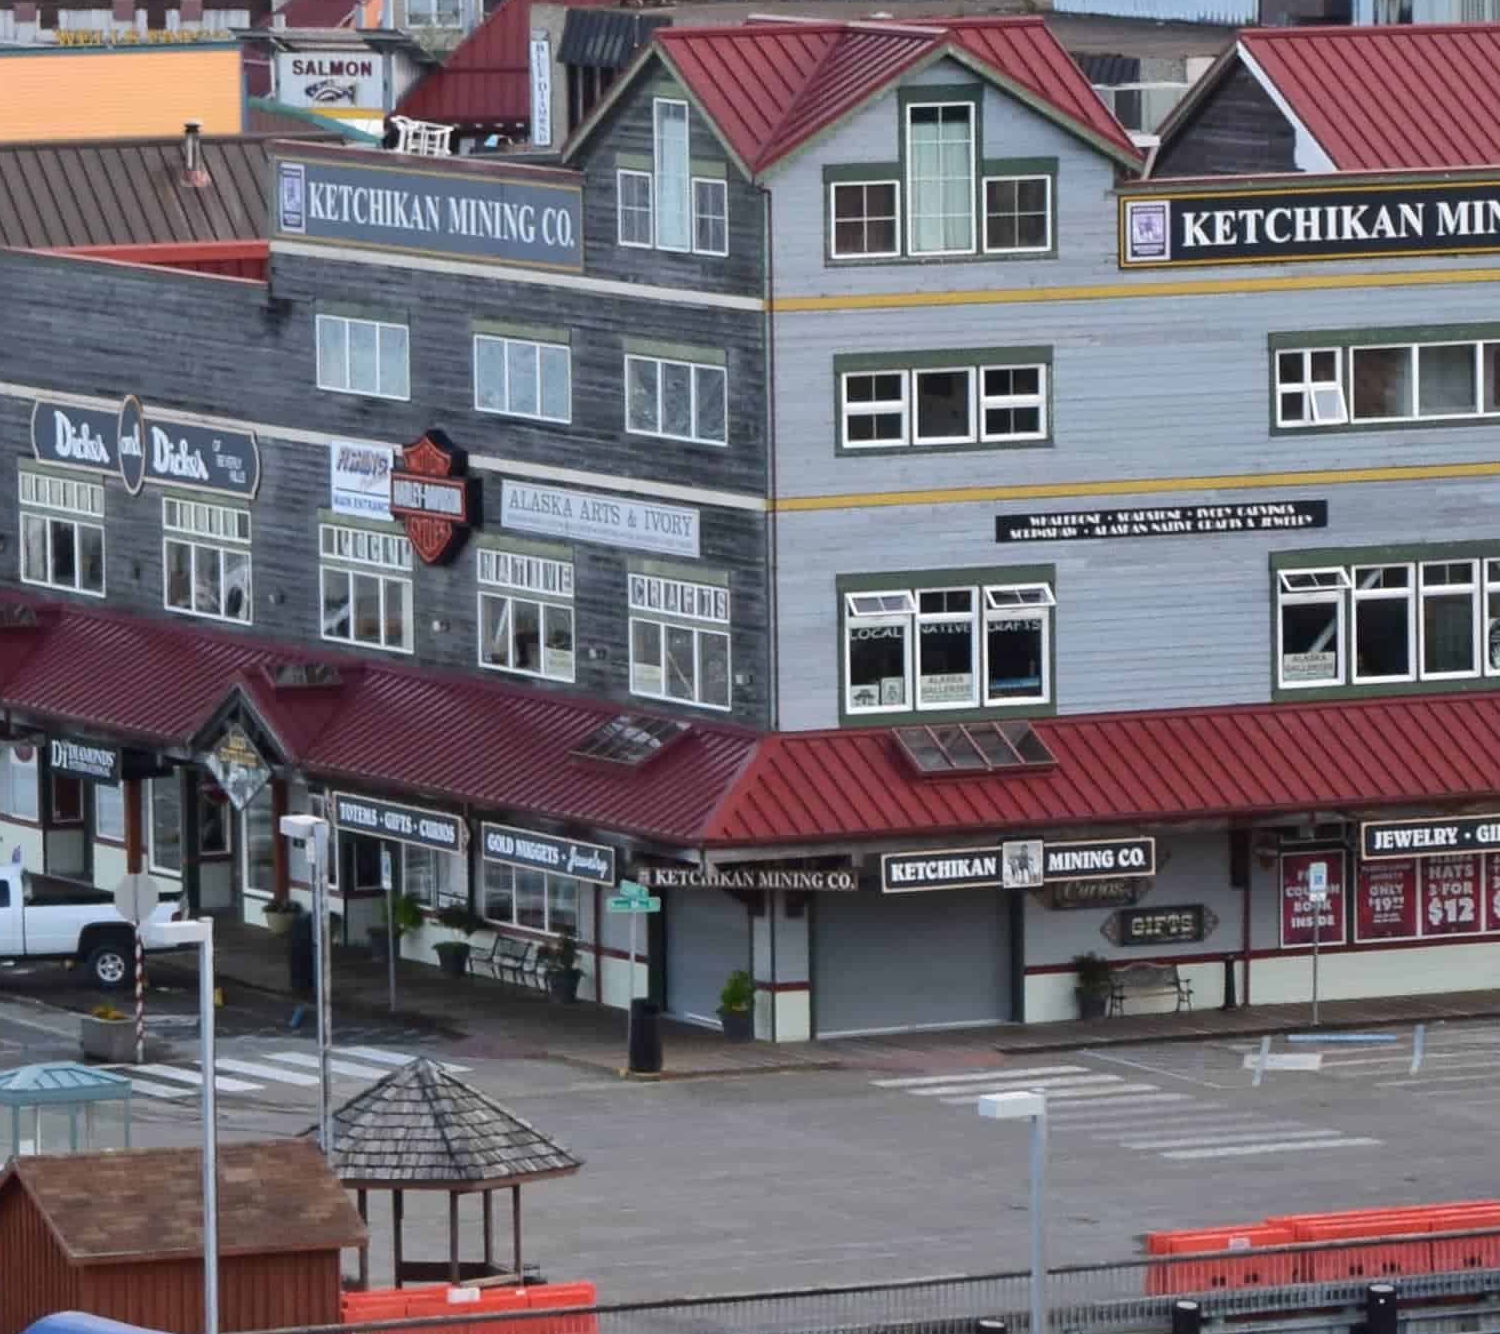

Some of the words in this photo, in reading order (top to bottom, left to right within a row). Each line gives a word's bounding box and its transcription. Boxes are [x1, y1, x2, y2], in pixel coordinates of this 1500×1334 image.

[292, 59, 373, 76] SALMON
[308, 181, 440, 233] KETCHIKAN
[448, 196, 535, 244] MINING
[542, 206, 576, 248] CO.
[1182, 202, 1425, 247] KETCHIKAN
[120, 423, 143, 458] and
[509, 490, 573, 517] ALASKA
[579, 499, 621, 525] ARTS
[627, 510, 637, 528] &
[644, 509, 693, 538] IVORY
[1009, 527, 1077, 540] SCRIMSHAW
[1094, 523, 1148, 537] ALASKAN
[1152, 520, 1192, 534] NATIVE
[1198, 517, 1242, 531] CRAFTS
[1246, 516, 1255, 528] &
[1261, 514, 1313, 527] JEWELRY
[1029, 513, 1100, 527] WHALEBONE
[1117, 509, 1182, 523] SOAPSTONE
[1196, 506, 1231, 519] IVORY
[1237, 503, 1294, 517] CARVINGS
[481, 551, 572, 595] NATIVE
[631, 577, 728, 618] CRAFTS
[850, 627, 904, 641] LOCAL
[987, 618, 1042, 633] CRAFTS
[339, 801, 377, 824] TOTEMS
[384, 810, 412, 833] GIFTS
[419, 818, 455, 844] CURIOS
[1374, 826, 1458, 850] JEWELRY
[487, 832, 514, 855] GOLD
[515, 836, 559, 865] NUGGETS
[566, 845, 609, 878] Jewelry
[891, 856, 997, 882] KETCHIKAN
[1049, 848, 1115, 871] MINING
[1117, 847, 1146, 867] CO.
[758, 870, 824, 889] MINING
[827, 871, 856, 890] CO.
[1429, 866, 1474, 880] HATS
[1064, 879, 1126, 898] Curios
[1369, 884, 1404, 897] ONLY
[1428, 898, 1475, 925] $12
[1131, 914, 1193, 936] GIFTS
